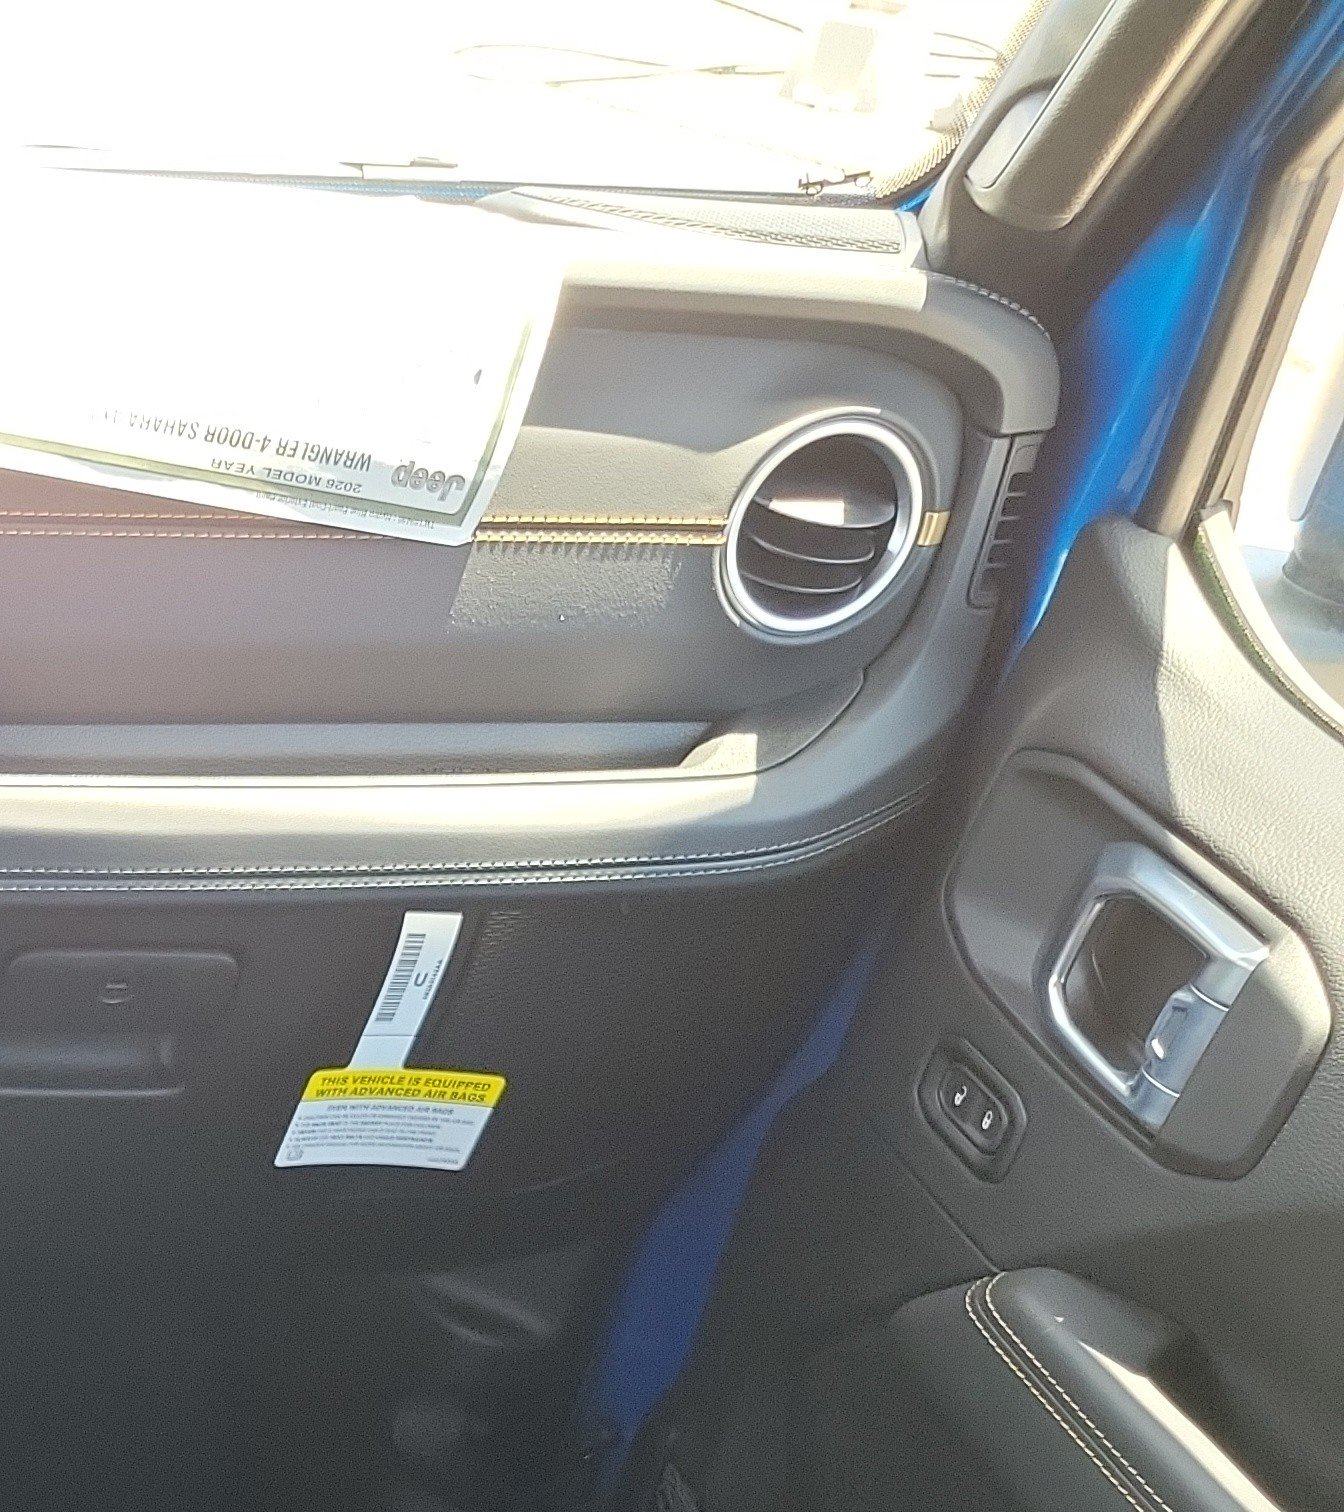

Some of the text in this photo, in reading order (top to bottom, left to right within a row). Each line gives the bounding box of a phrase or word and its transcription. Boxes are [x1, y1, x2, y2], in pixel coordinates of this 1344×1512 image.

[129, 410, 198, 439] SAHARA
[204, 423, 270, 453] 4-DOOR
[276, 437, 371, 473] WRANGLER
[211, 458, 362, 493] 2026 MODEL YEAR
[391, 461, 466, 501] Jeep
[316, 1087, 486, 1103] WITH ADVANCED AIR BAGS
[322, 1076, 491, 1092] THIS VEHICLE IS EQUIPPED
